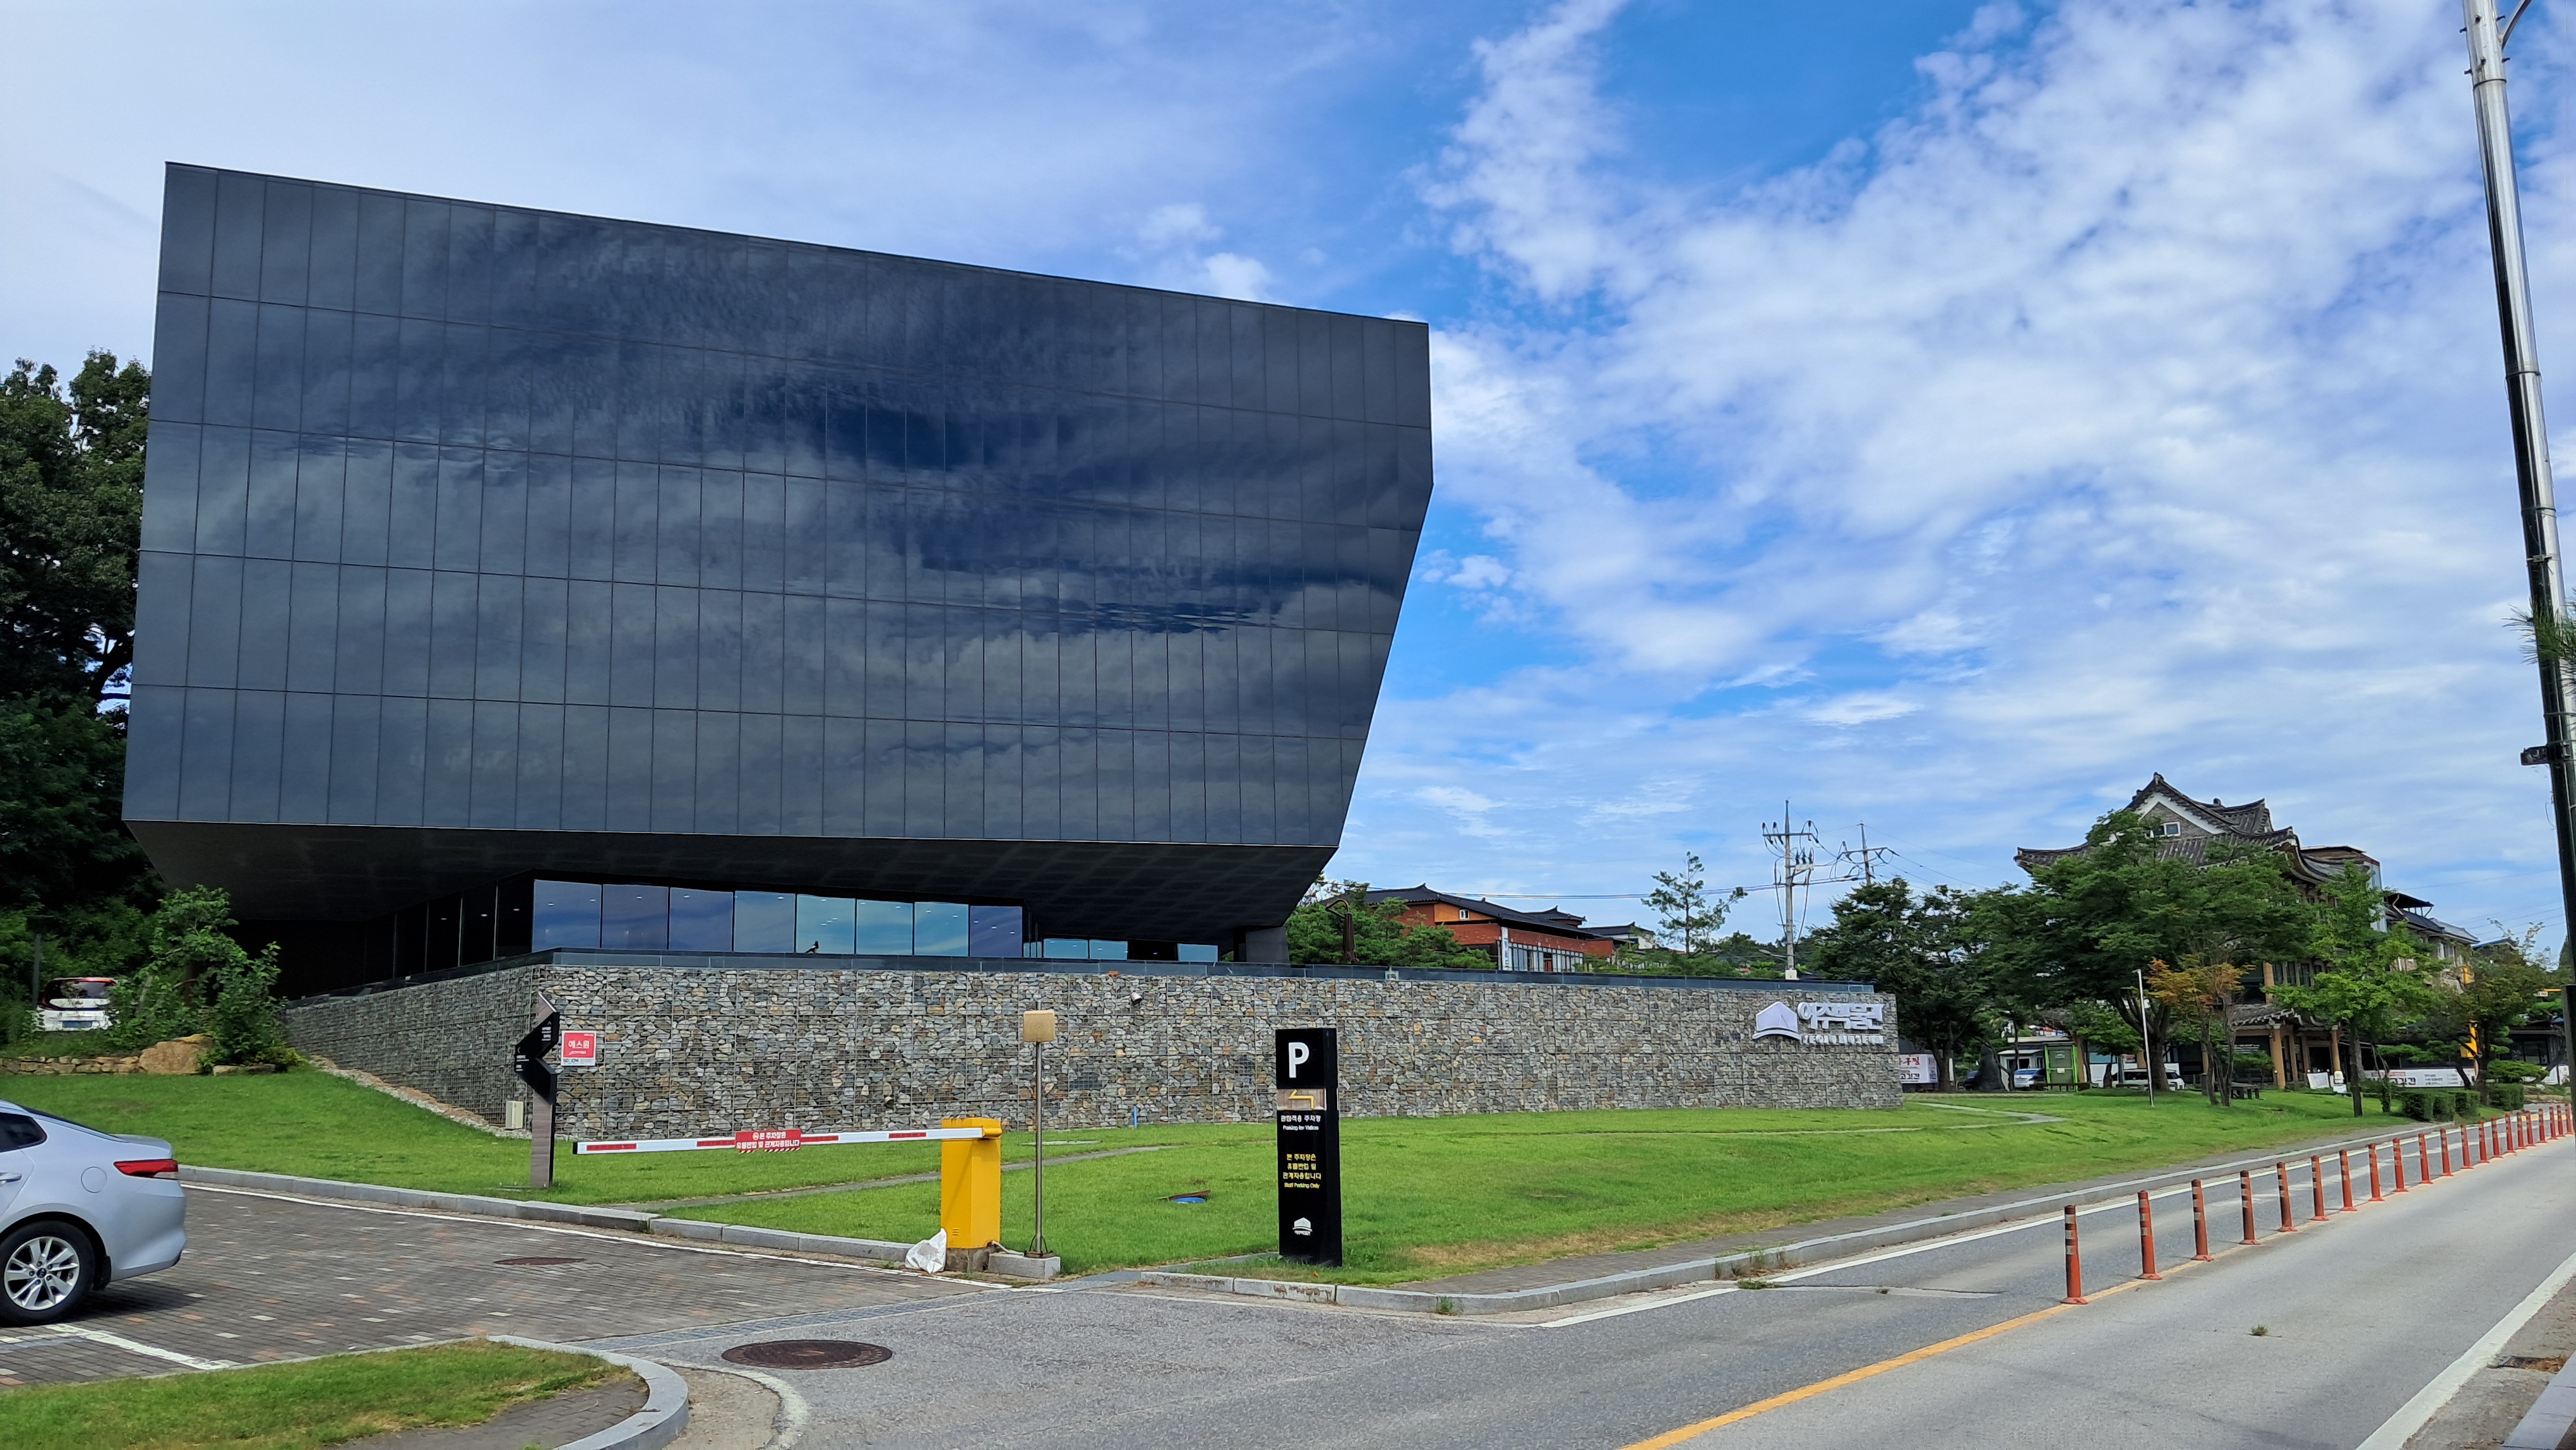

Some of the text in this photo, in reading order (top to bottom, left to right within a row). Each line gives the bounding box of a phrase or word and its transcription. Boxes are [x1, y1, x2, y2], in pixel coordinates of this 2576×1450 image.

[1798, 1002, 1884, 1029] 여주박물관
[1801, 1034, 1883, 1044] YEOJU MUSEUM
[1289, 1042, 1309, 1078] P
